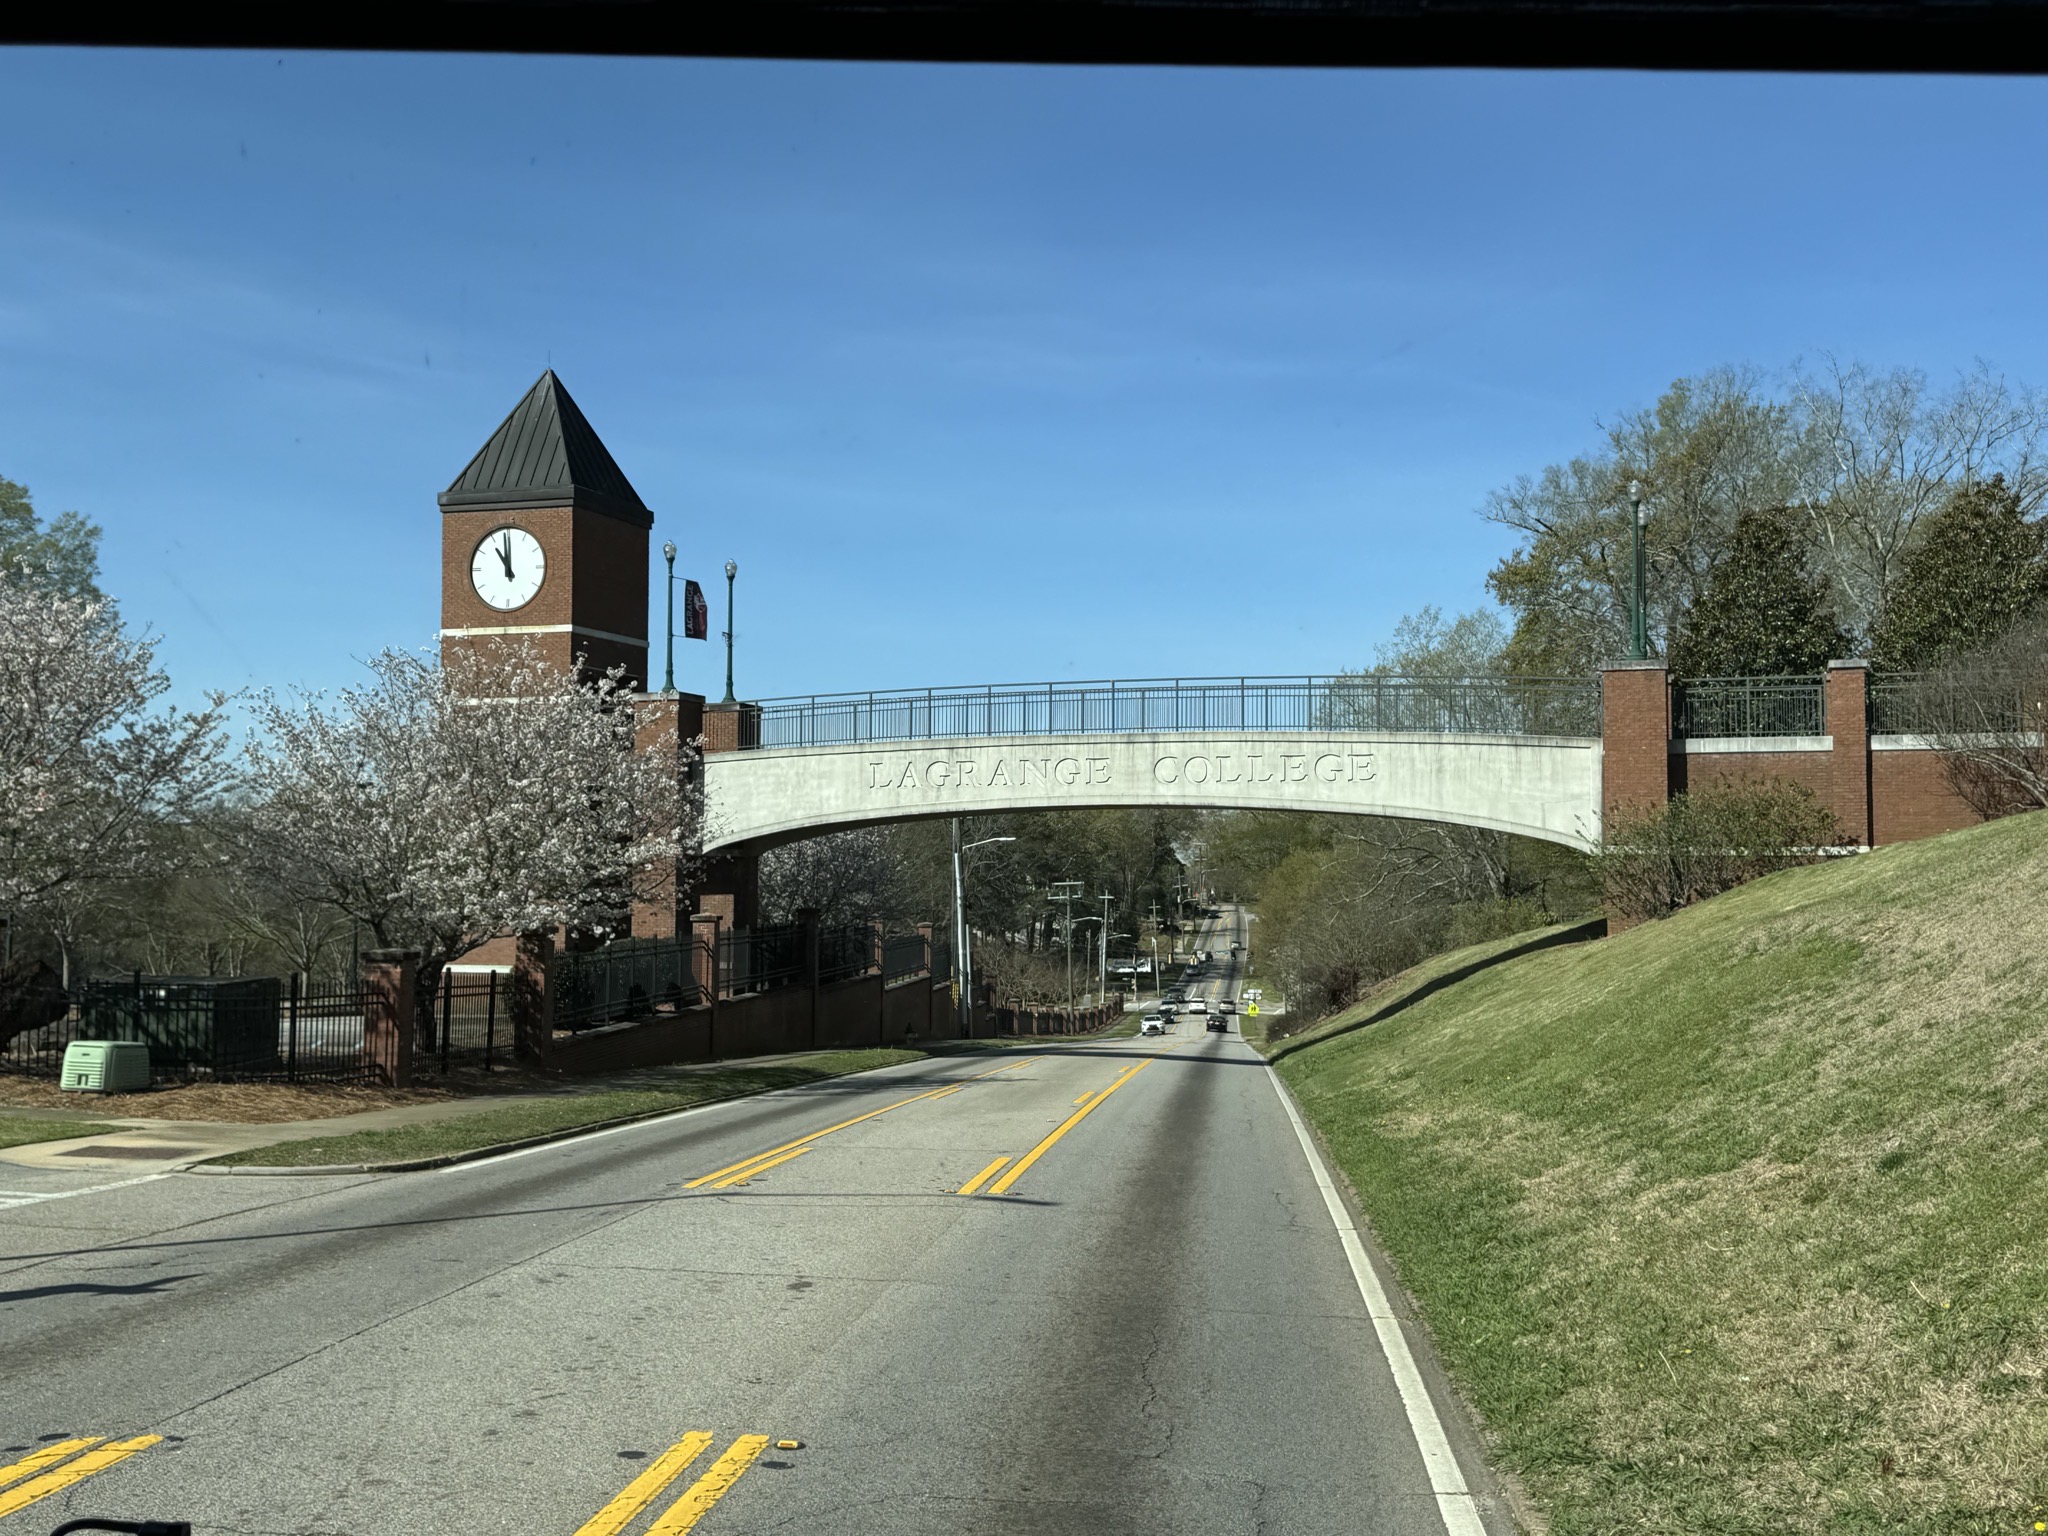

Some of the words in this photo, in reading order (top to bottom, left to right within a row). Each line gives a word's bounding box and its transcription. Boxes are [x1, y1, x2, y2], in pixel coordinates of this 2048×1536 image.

[686, 584, 694, 635] LAGRANGE
[868, 757, 1113, 789] LAGRANGE
[1152, 753, 1378, 784] COLLEGE
